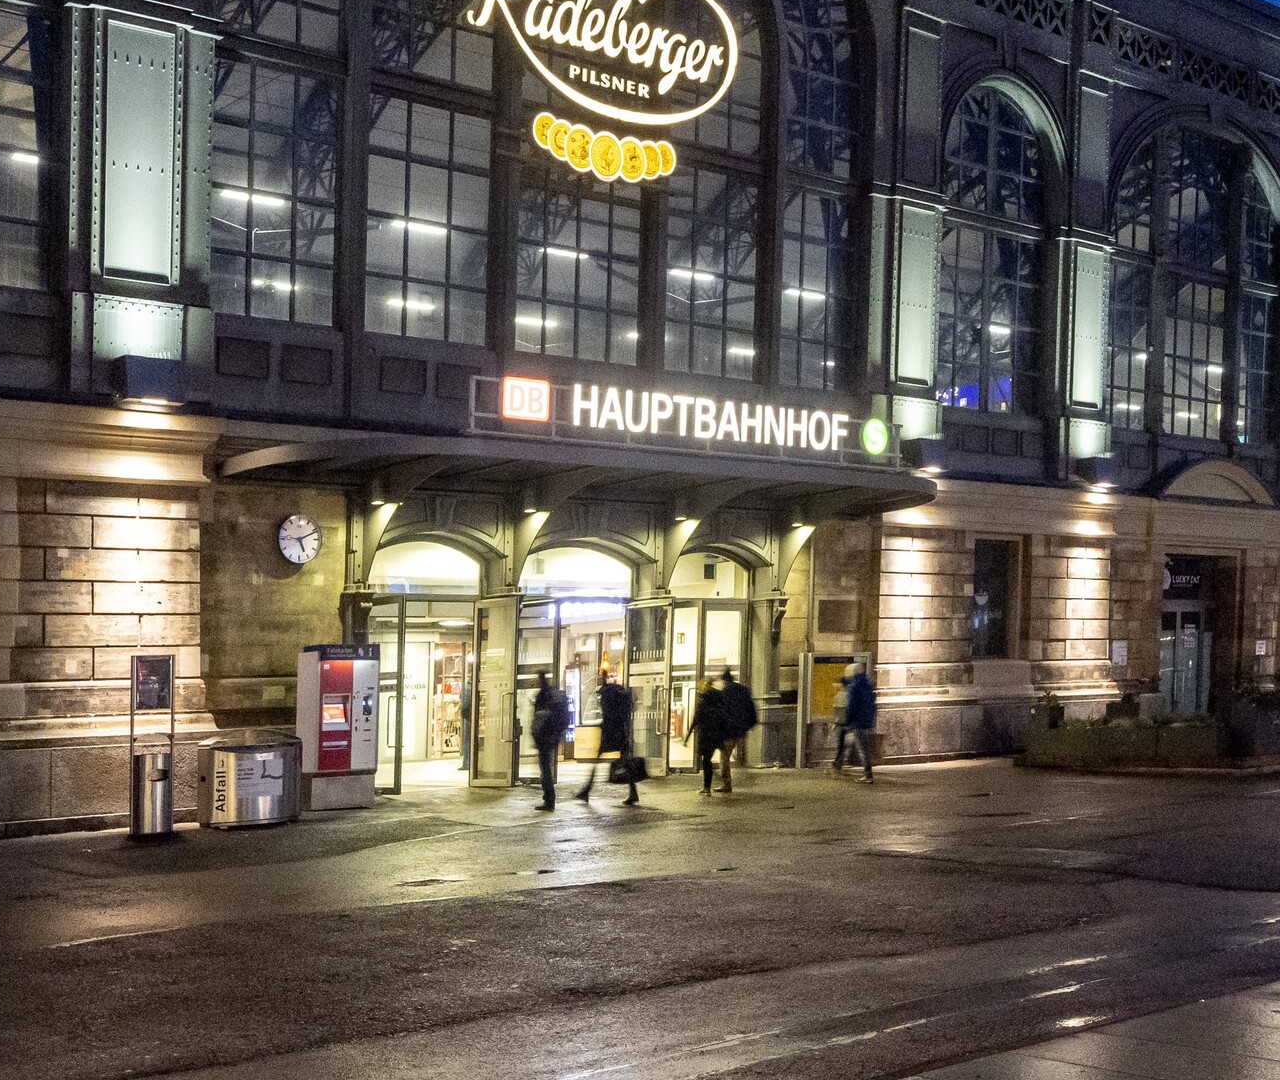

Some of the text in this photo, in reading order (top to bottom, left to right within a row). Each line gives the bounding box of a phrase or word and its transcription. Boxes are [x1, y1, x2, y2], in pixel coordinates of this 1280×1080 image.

[569, 64, 650, 99] PILSNER
[508, 385, 544, 414] DB
[572, 383, 849, 451] HAUPTBAHNHOF
[1172, 575, 1190, 584] LUCKY
[215, 771, 227, 812] Abfall
